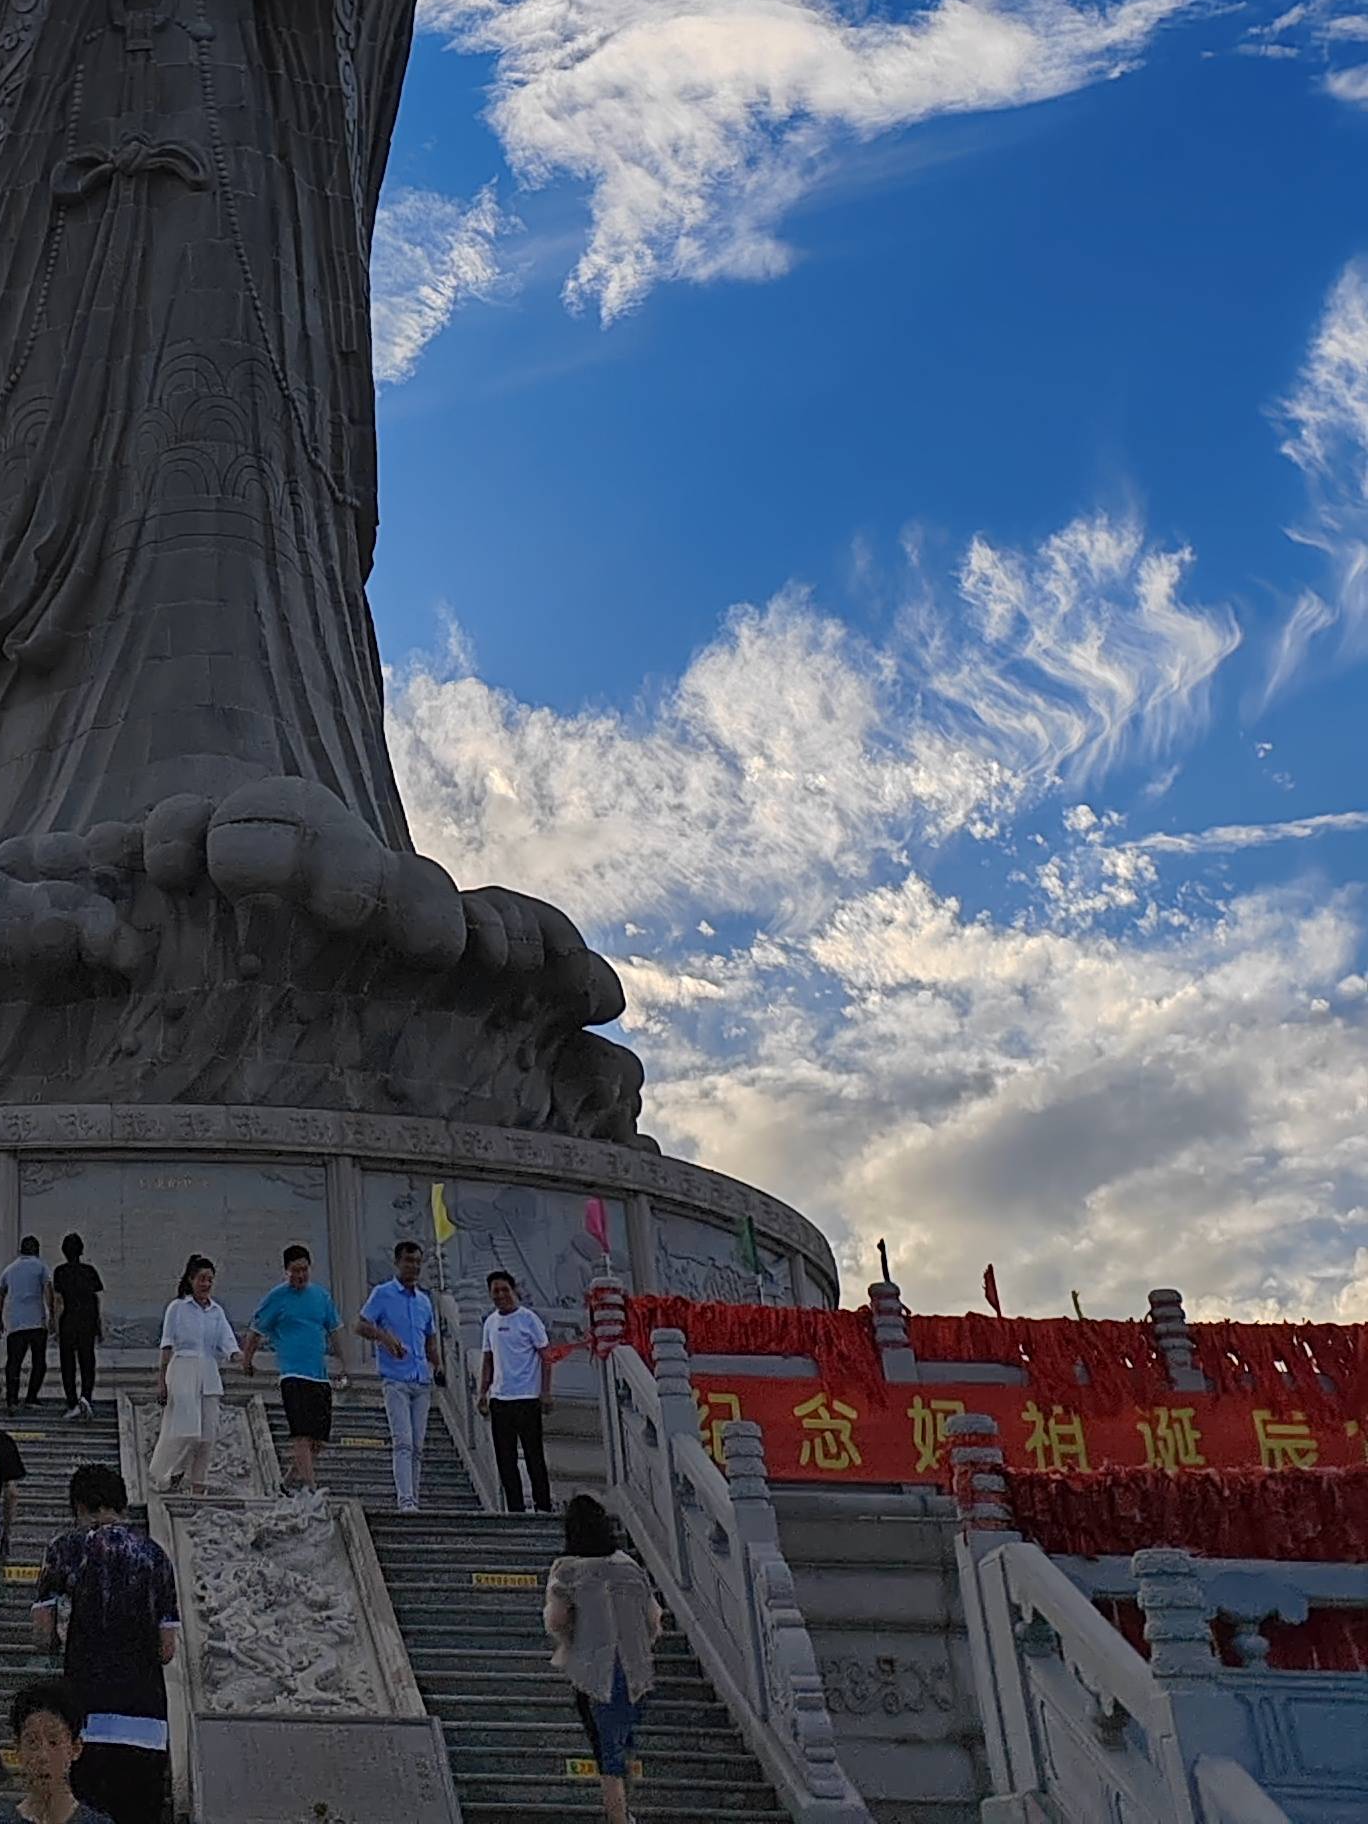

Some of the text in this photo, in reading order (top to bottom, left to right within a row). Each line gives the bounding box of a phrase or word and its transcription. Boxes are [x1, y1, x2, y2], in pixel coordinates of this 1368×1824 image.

[690, 1389, 1368, 1471] 纪念妈祖诞辰
